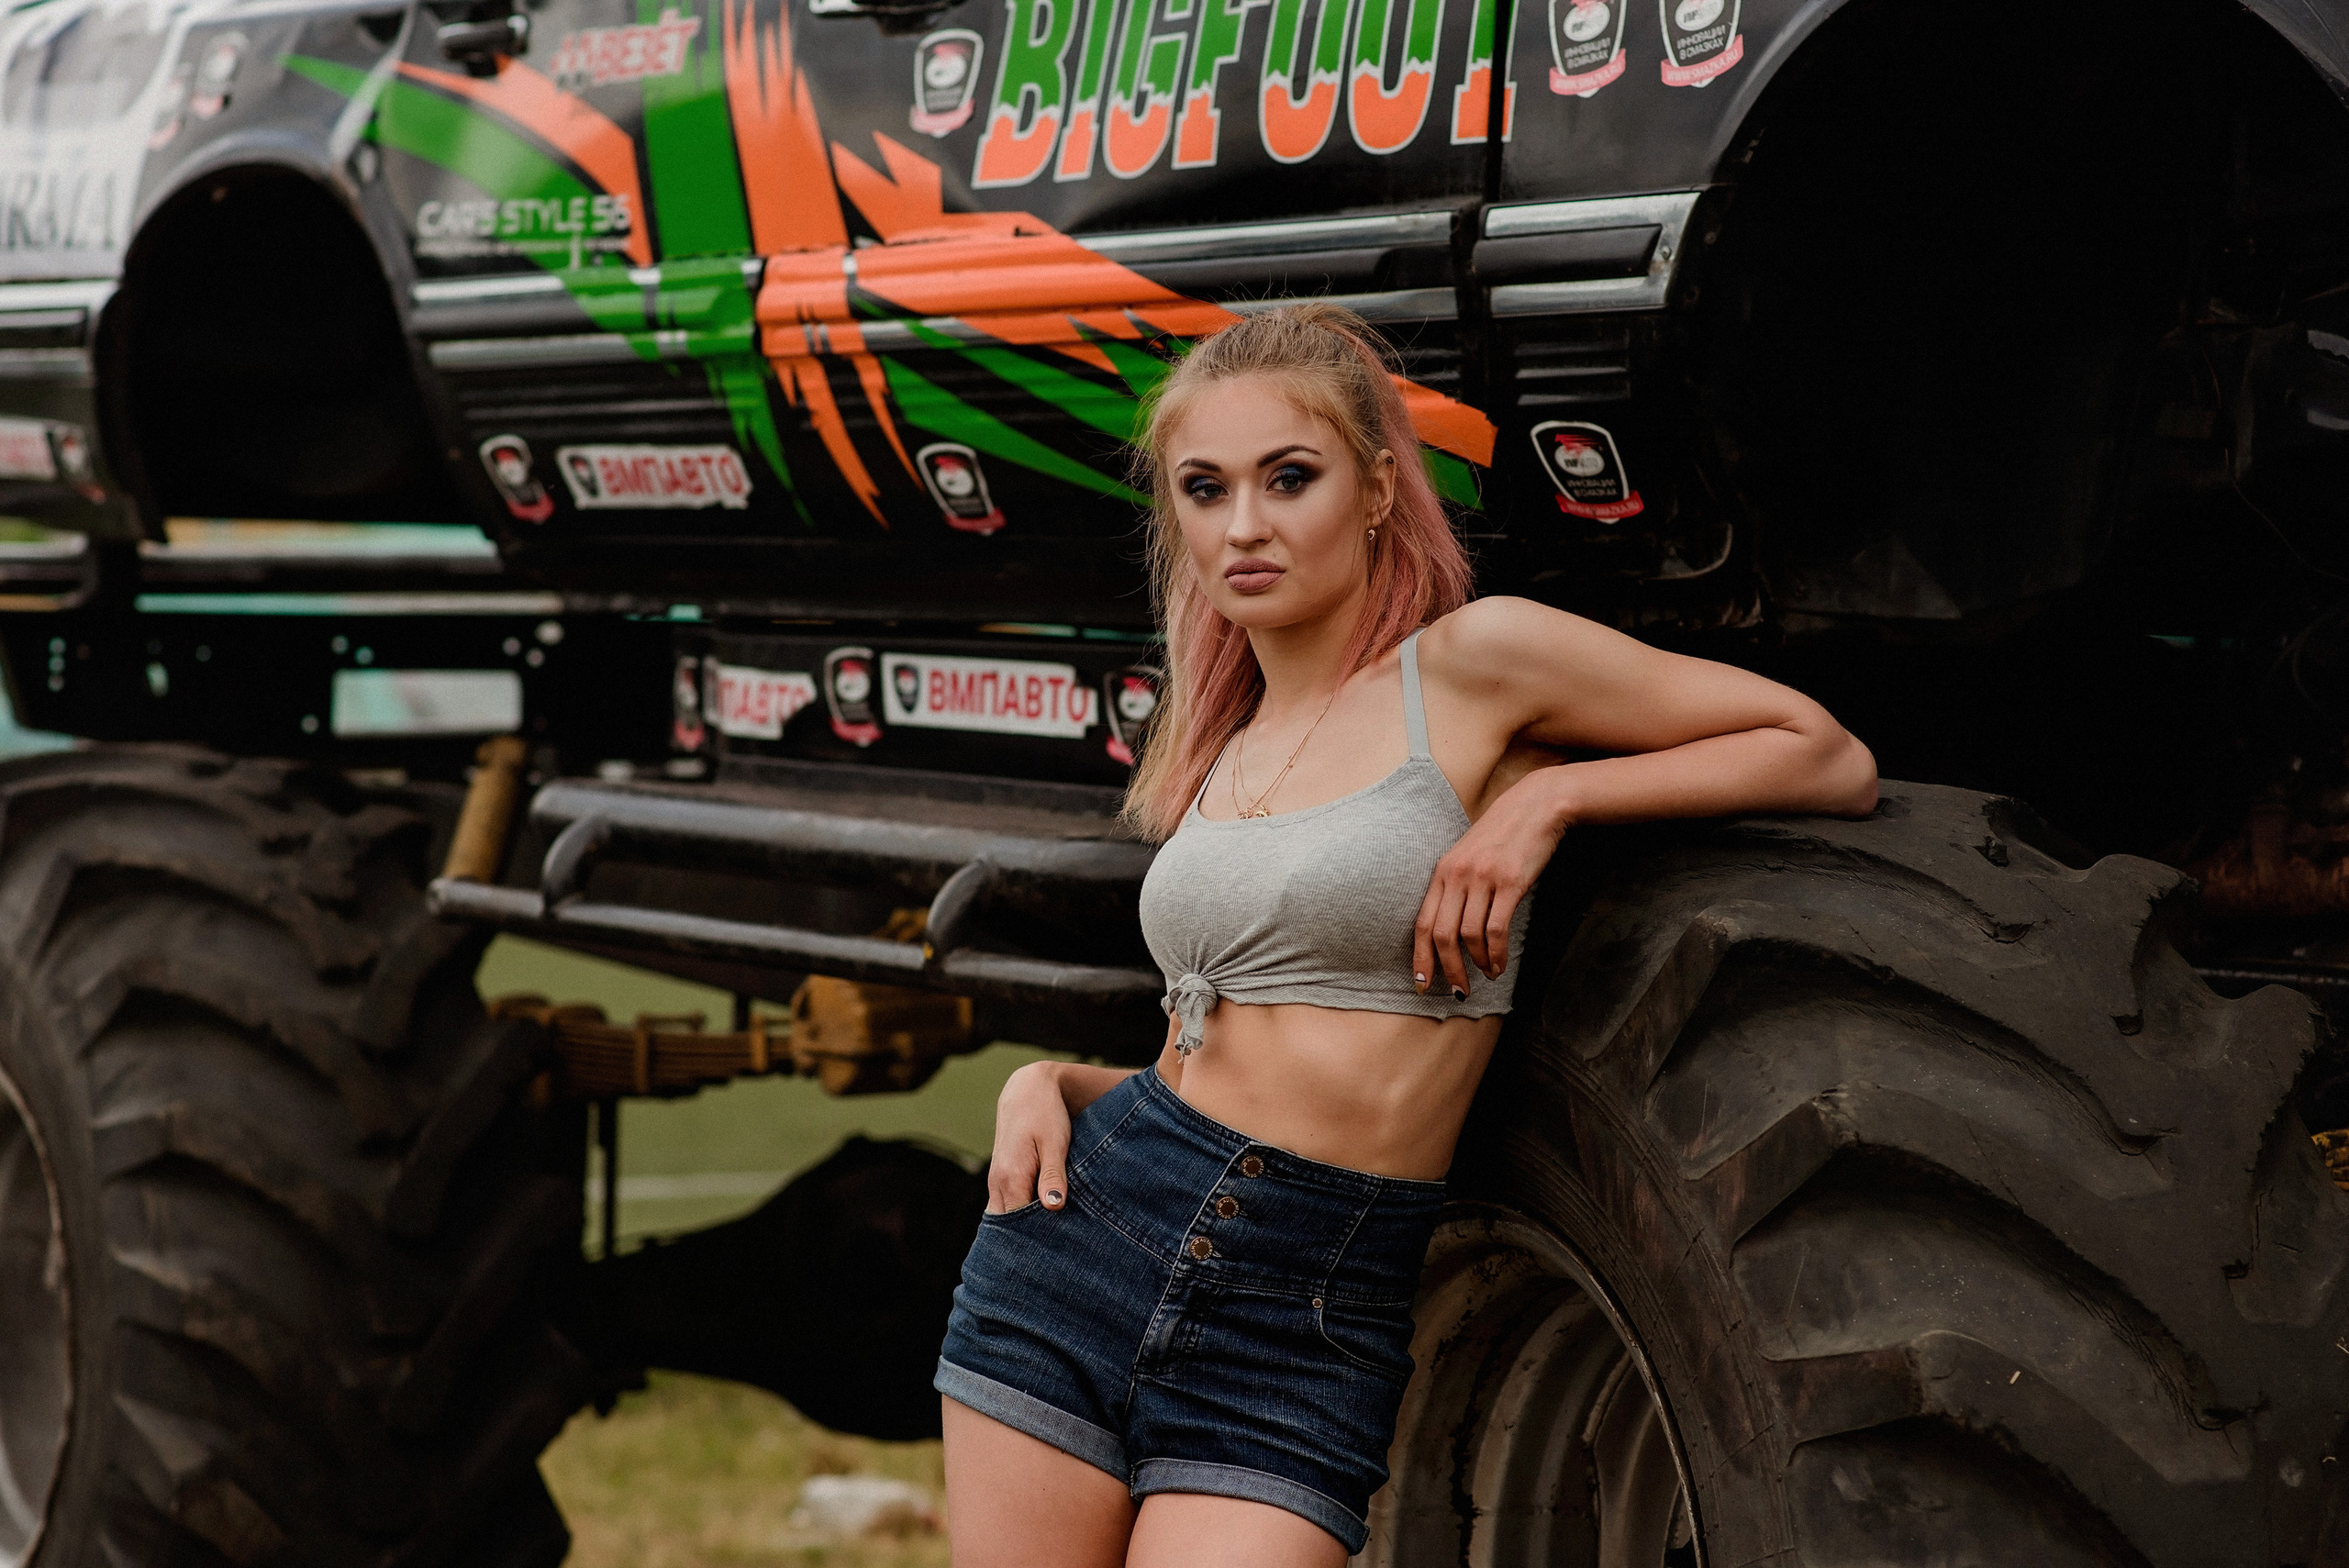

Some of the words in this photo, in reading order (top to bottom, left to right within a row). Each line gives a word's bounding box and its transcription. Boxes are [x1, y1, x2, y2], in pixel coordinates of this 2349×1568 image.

[500, 195, 587, 235] STYLE
[591, 193, 633, 231] 56
[598, 456, 743, 495] ВМПАВТО
[927, 669, 1089, 723] ВМПАВТО
